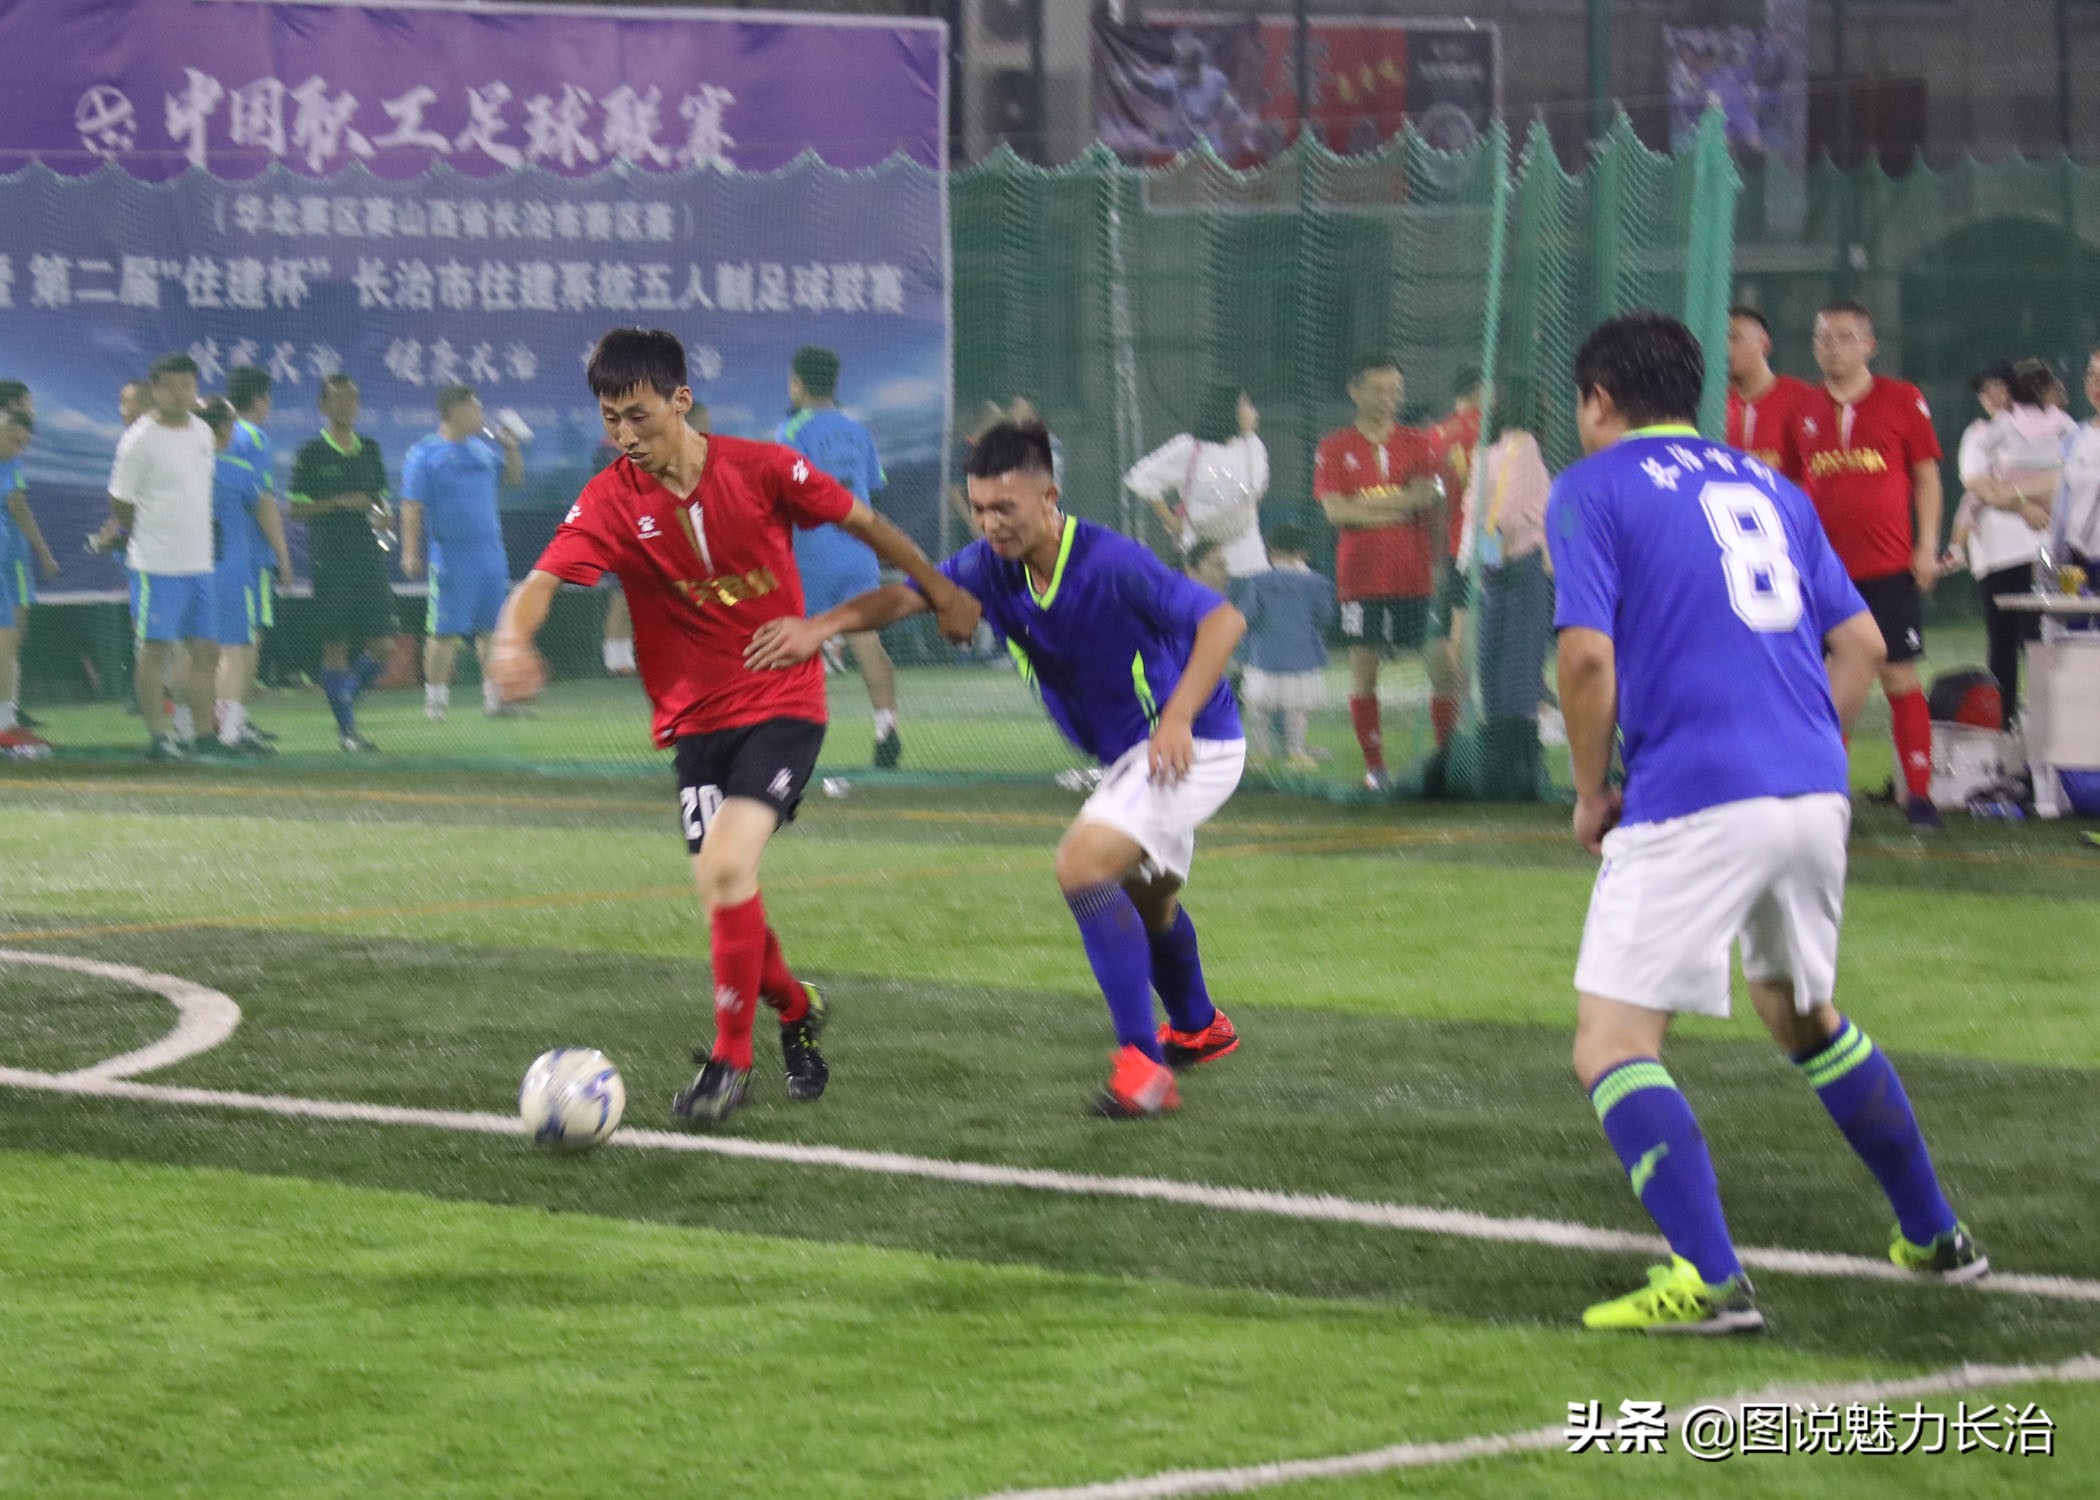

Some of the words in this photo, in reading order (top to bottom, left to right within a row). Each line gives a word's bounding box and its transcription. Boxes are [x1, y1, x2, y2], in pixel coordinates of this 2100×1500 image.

[165, 66, 737, 173] 中国职工足球联赛
[1698, 480, 1803, 632] 8
[680, 784, 724, 840] 20
